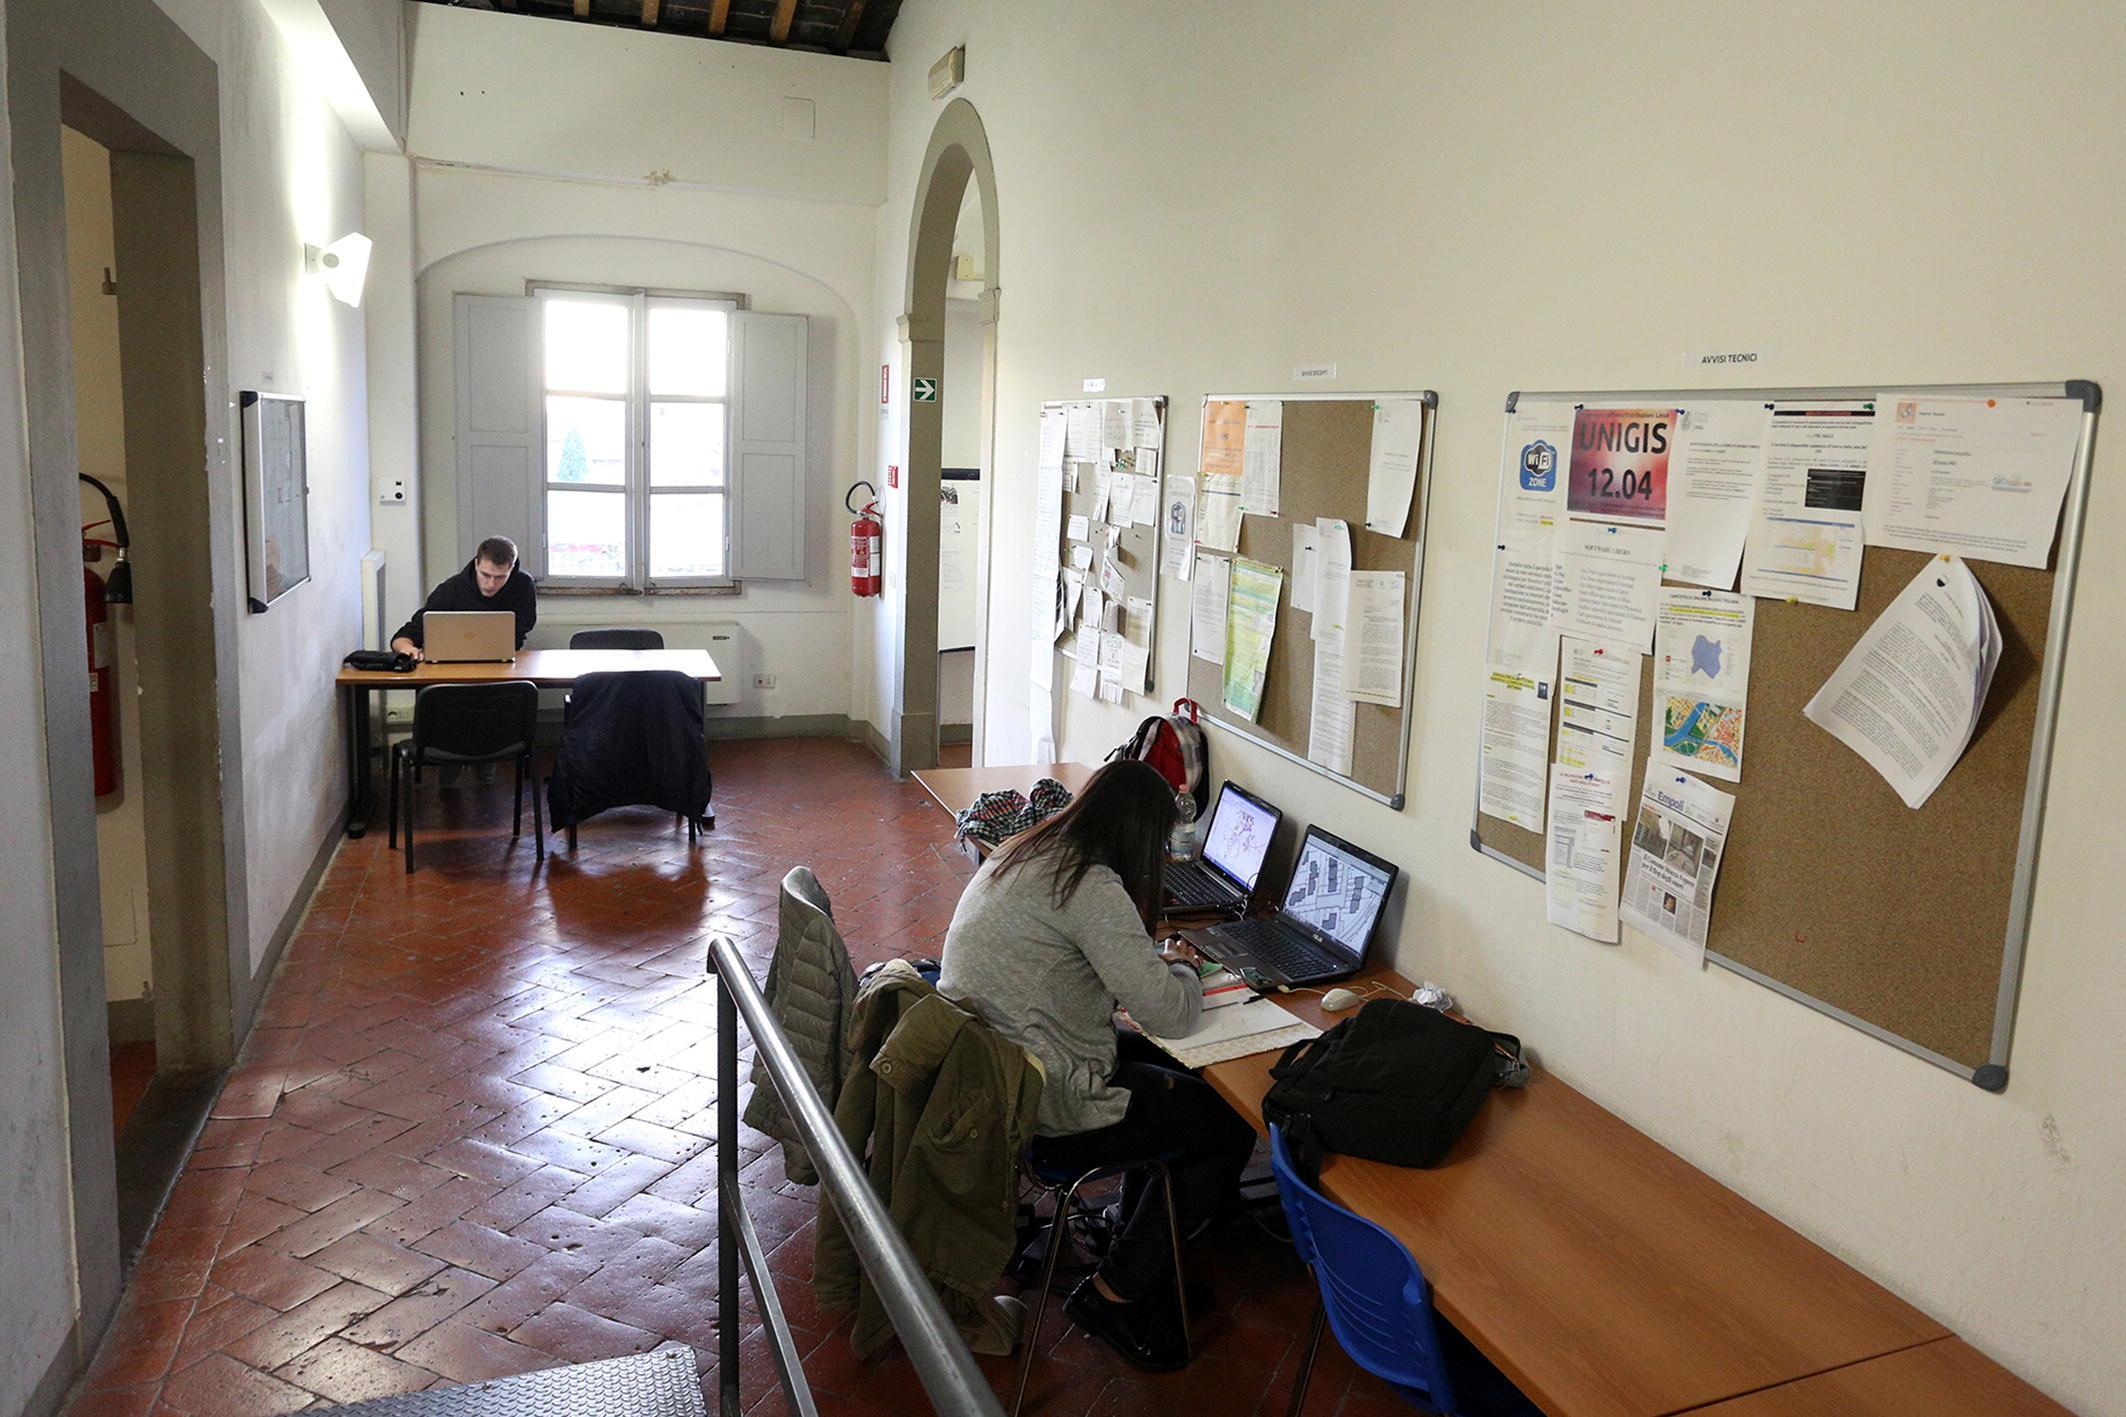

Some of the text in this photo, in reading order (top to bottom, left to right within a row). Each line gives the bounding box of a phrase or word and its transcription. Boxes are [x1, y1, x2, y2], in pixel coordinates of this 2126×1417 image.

[1701, 353, 1757, 364] AVVISI TECNICI
[1579, 422, 1667, 454] UNIGIS
[1527, 477, 1547, 488] ZONE
[1588, 467, 1653, 501] 12.04
[1657, 790, 1686, 812] Empoli
